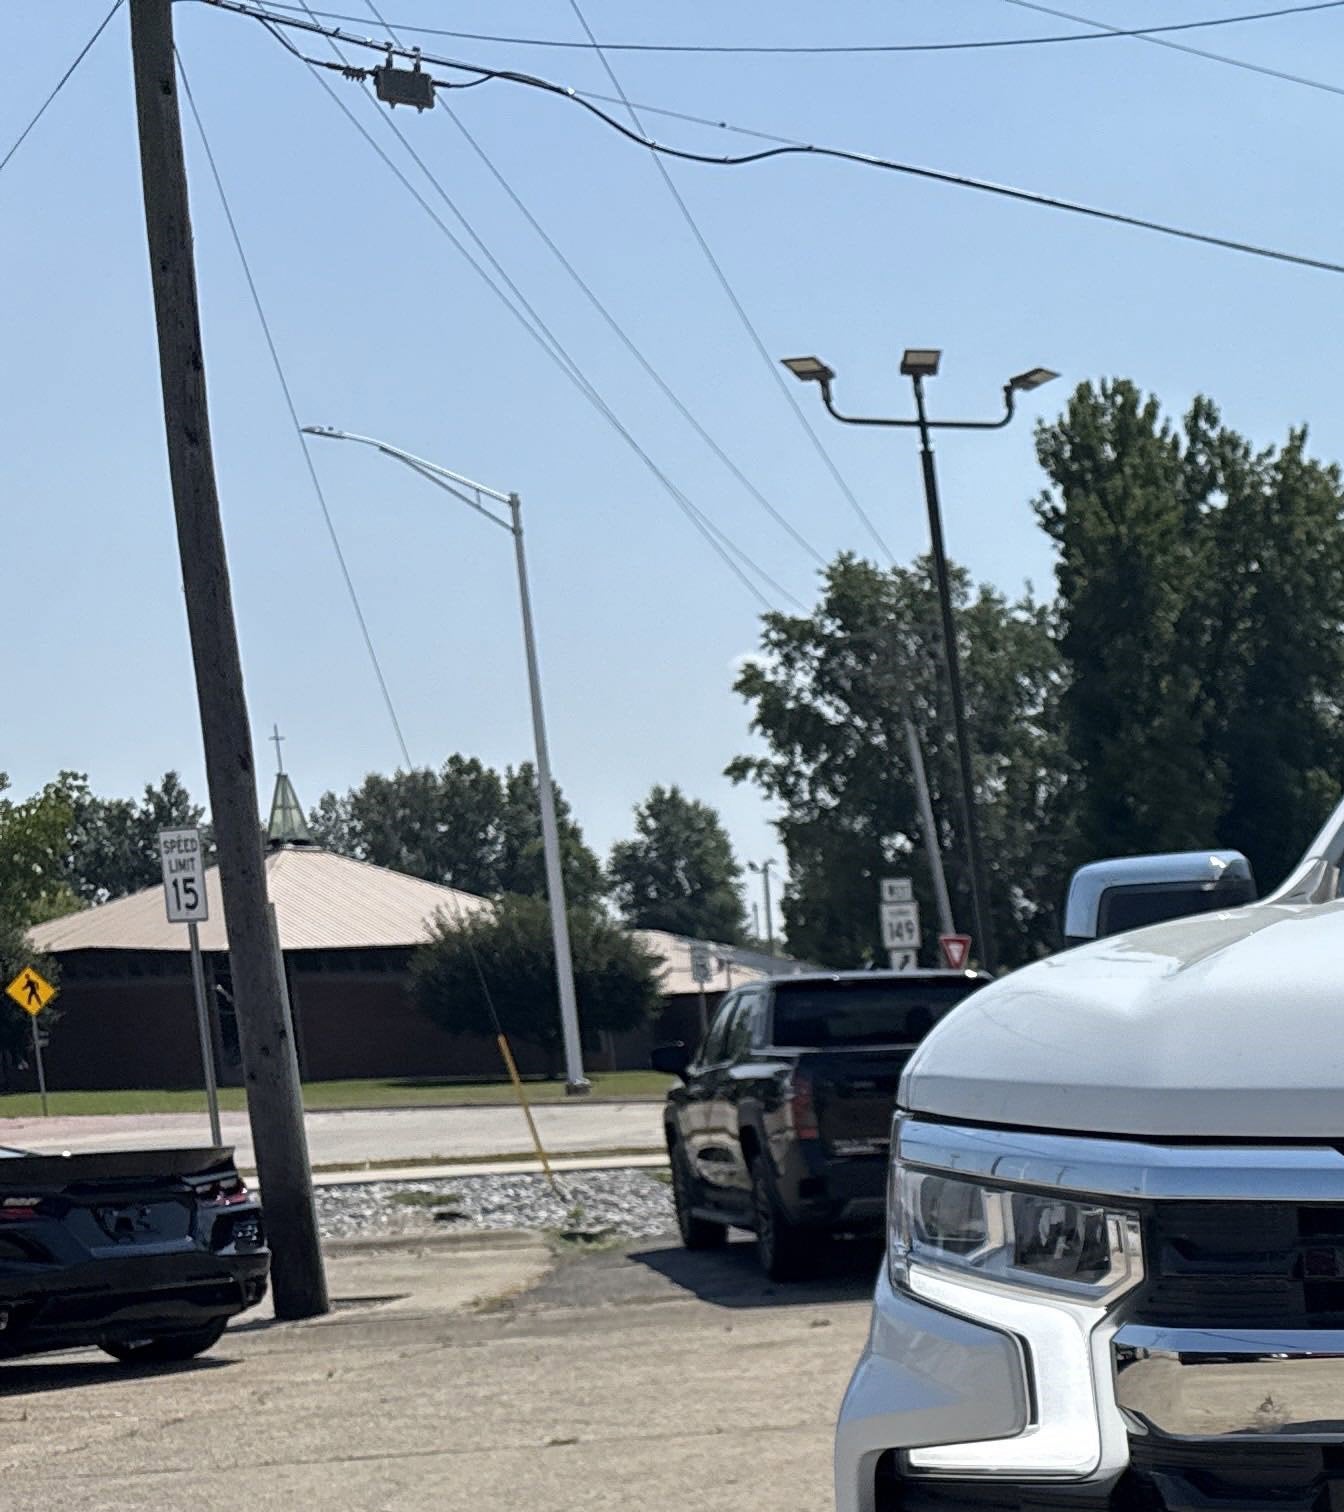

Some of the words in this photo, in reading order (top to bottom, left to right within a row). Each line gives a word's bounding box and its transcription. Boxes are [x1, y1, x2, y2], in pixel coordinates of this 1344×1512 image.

[163, 839, 198, 854] SPEED
[169, 857, 196, 873] LIMIT
[172, 877, 199, 911] 15
[888, 920, 915, 942] 149
